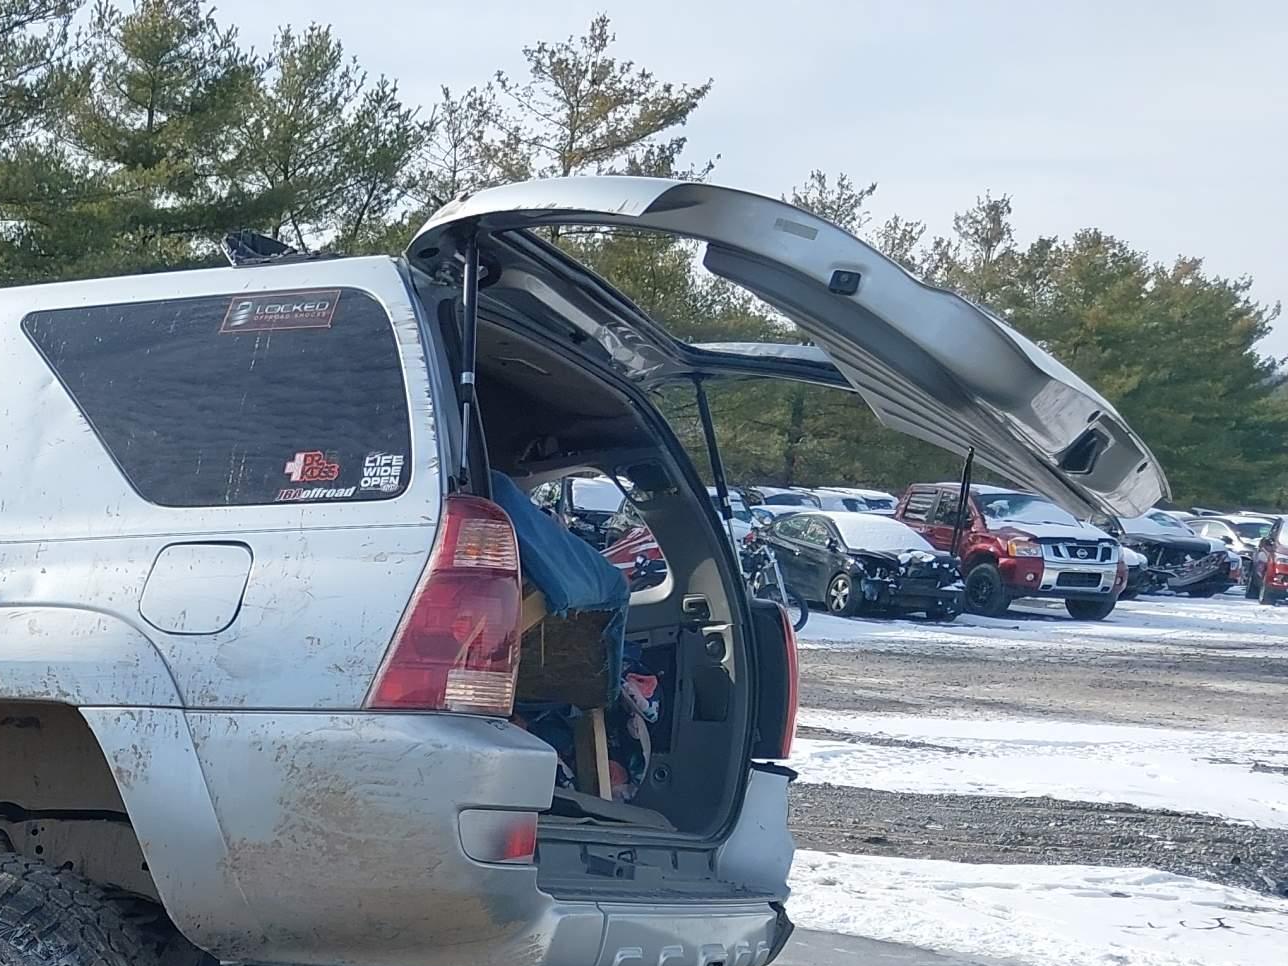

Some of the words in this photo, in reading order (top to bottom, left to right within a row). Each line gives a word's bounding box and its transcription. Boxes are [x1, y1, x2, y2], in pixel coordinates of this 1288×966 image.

[255, 301, 330, 315] LOCKED
[364, 454, 404, 467] LIFE
[363, 466, 402, 477] WIDE
[360, 476, 400, 488] OPEN
